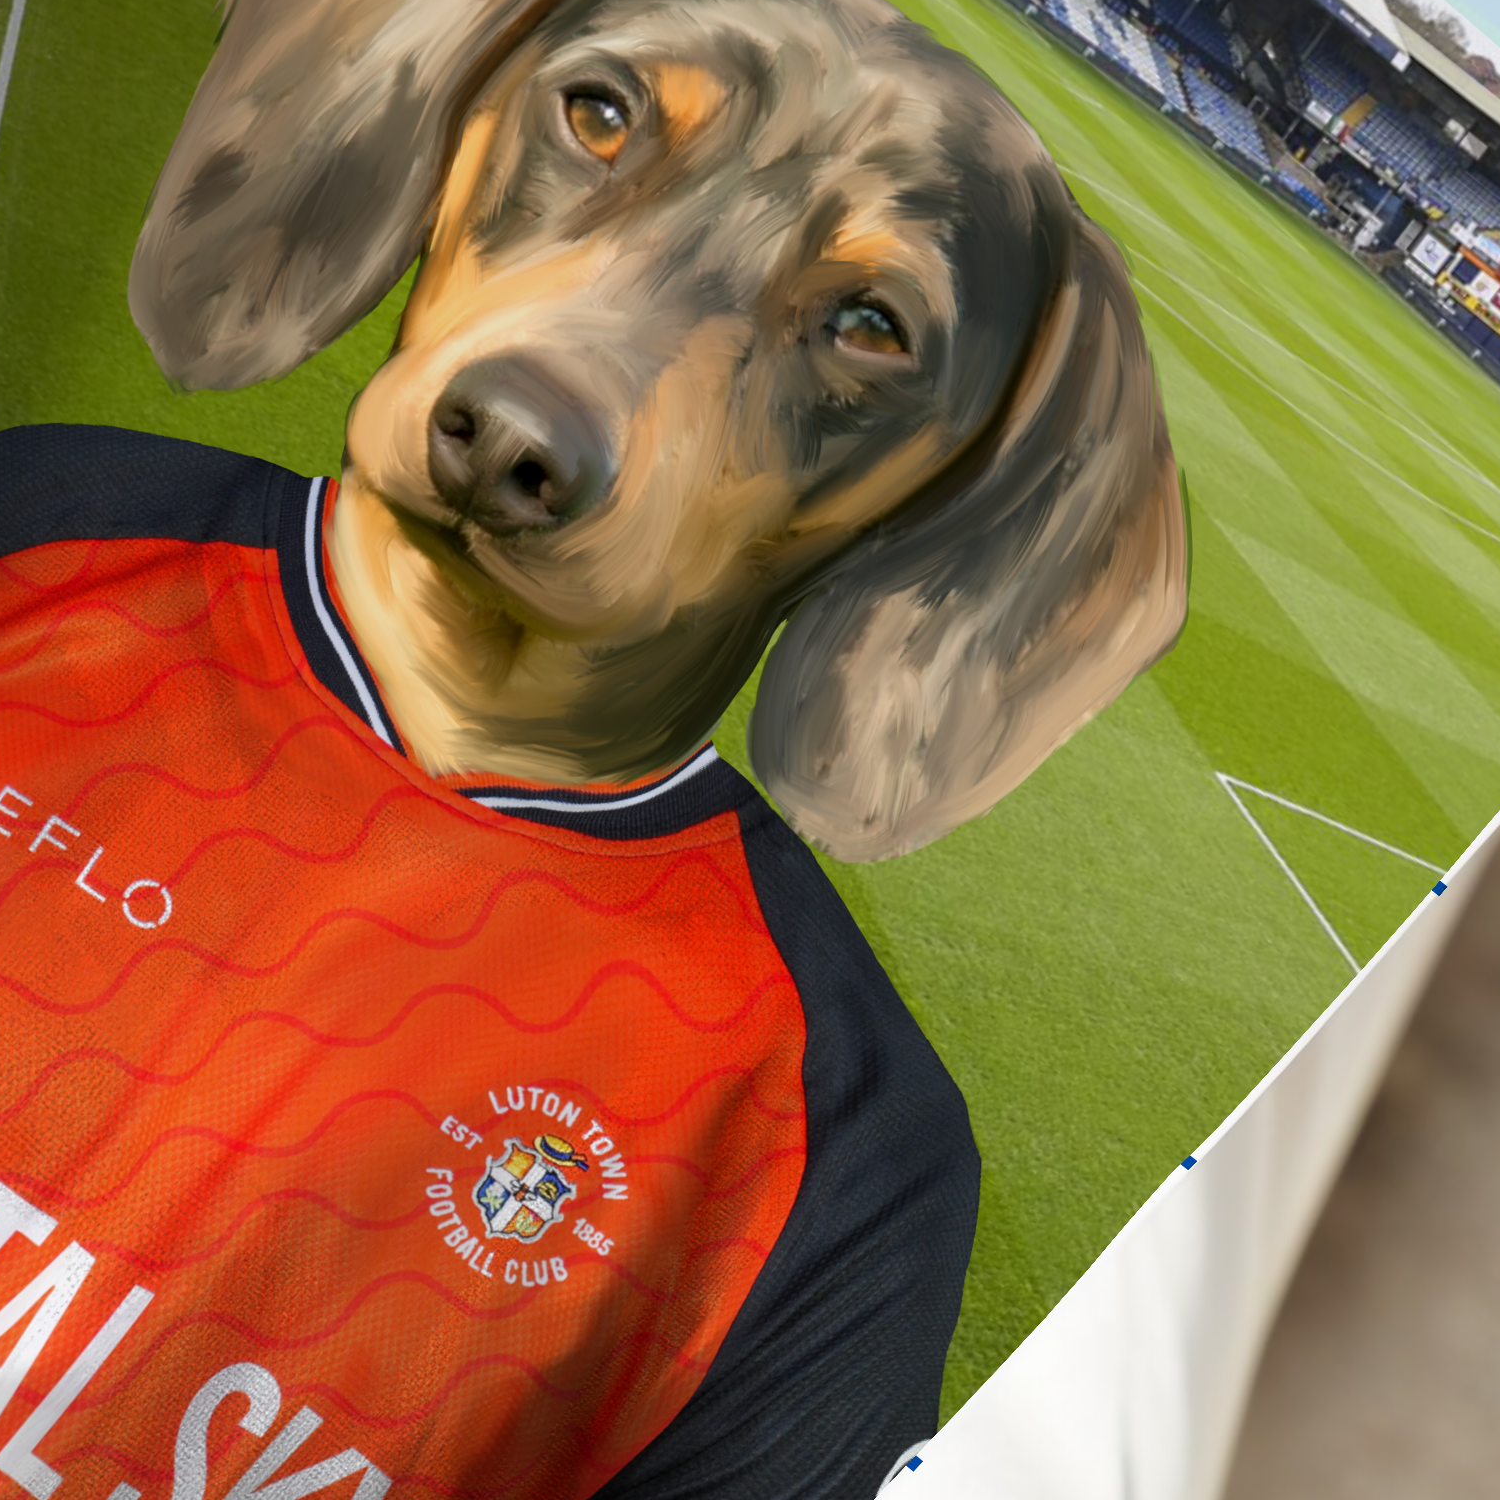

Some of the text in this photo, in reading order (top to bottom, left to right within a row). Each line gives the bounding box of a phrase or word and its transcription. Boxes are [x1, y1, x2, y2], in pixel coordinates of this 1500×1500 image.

[439, 1114, 484, 1152] EST
[487, 1085, 629, 1202] LUTON TOWN
[425, 1166, 569, 1288] FOOTBALL CLUB
[572, 1216, 617, 1258] 1885
